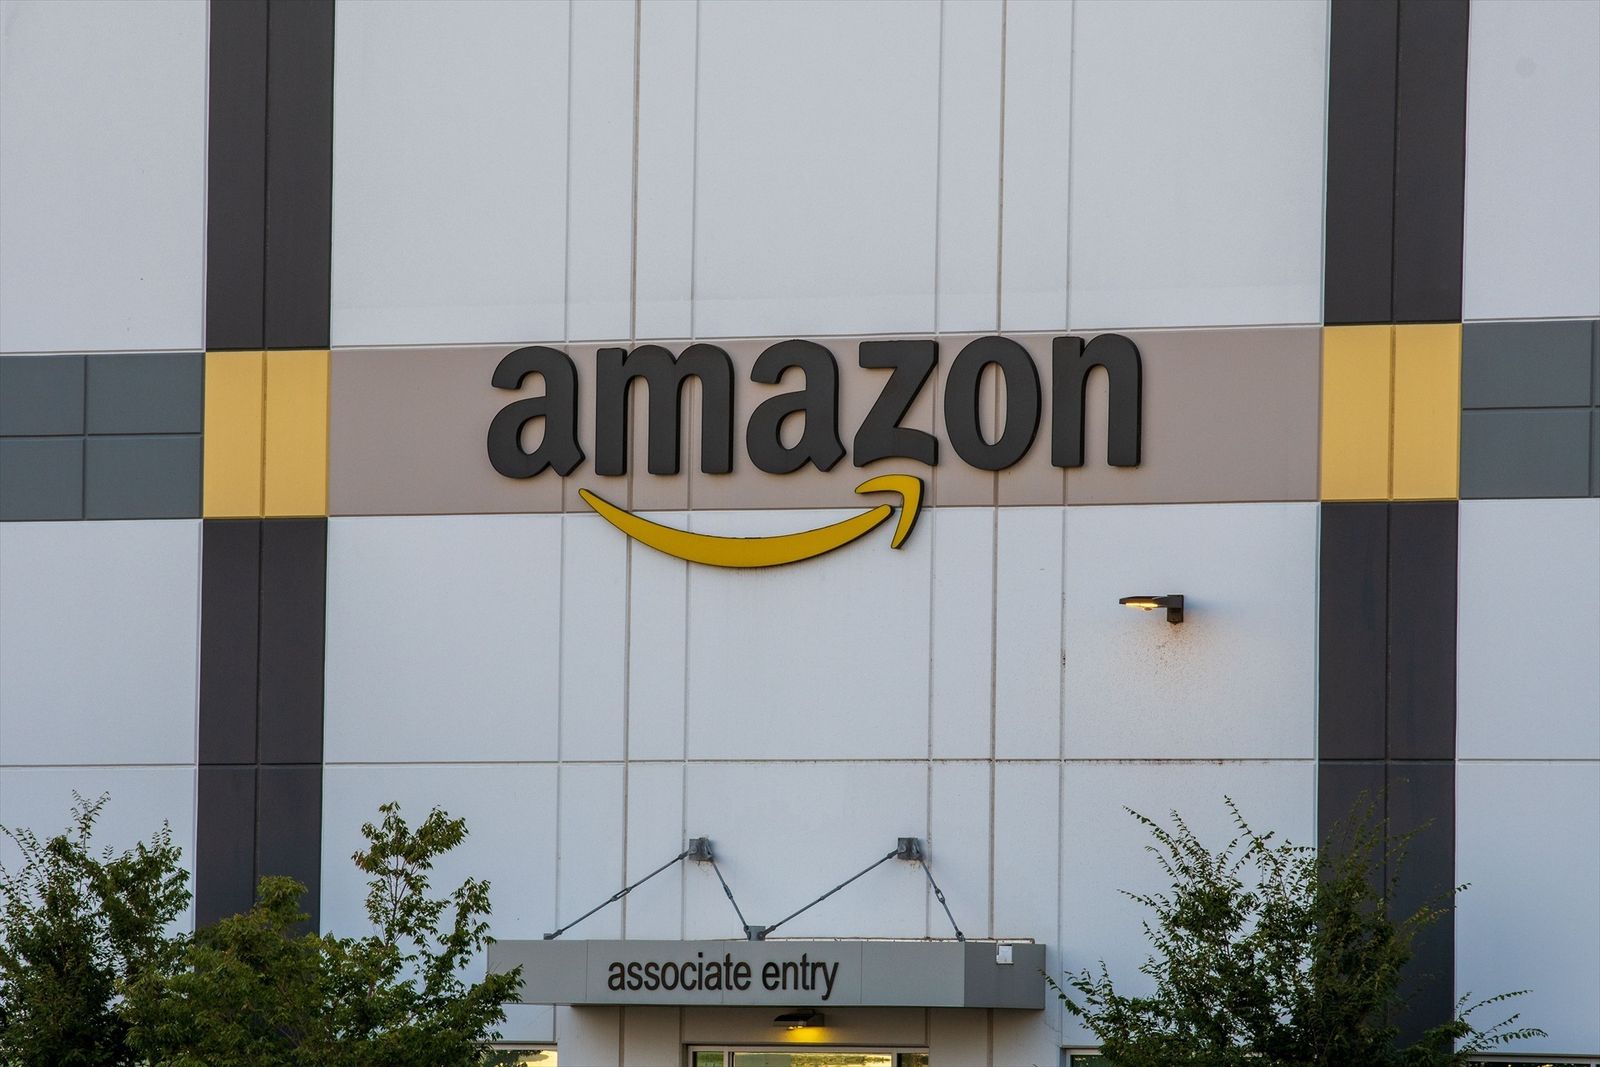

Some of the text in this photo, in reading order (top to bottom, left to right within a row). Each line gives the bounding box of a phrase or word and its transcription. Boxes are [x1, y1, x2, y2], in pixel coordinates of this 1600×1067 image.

[487, 333, 1142, 478] amazon
[608, 952, 839, 1000] associate entry
